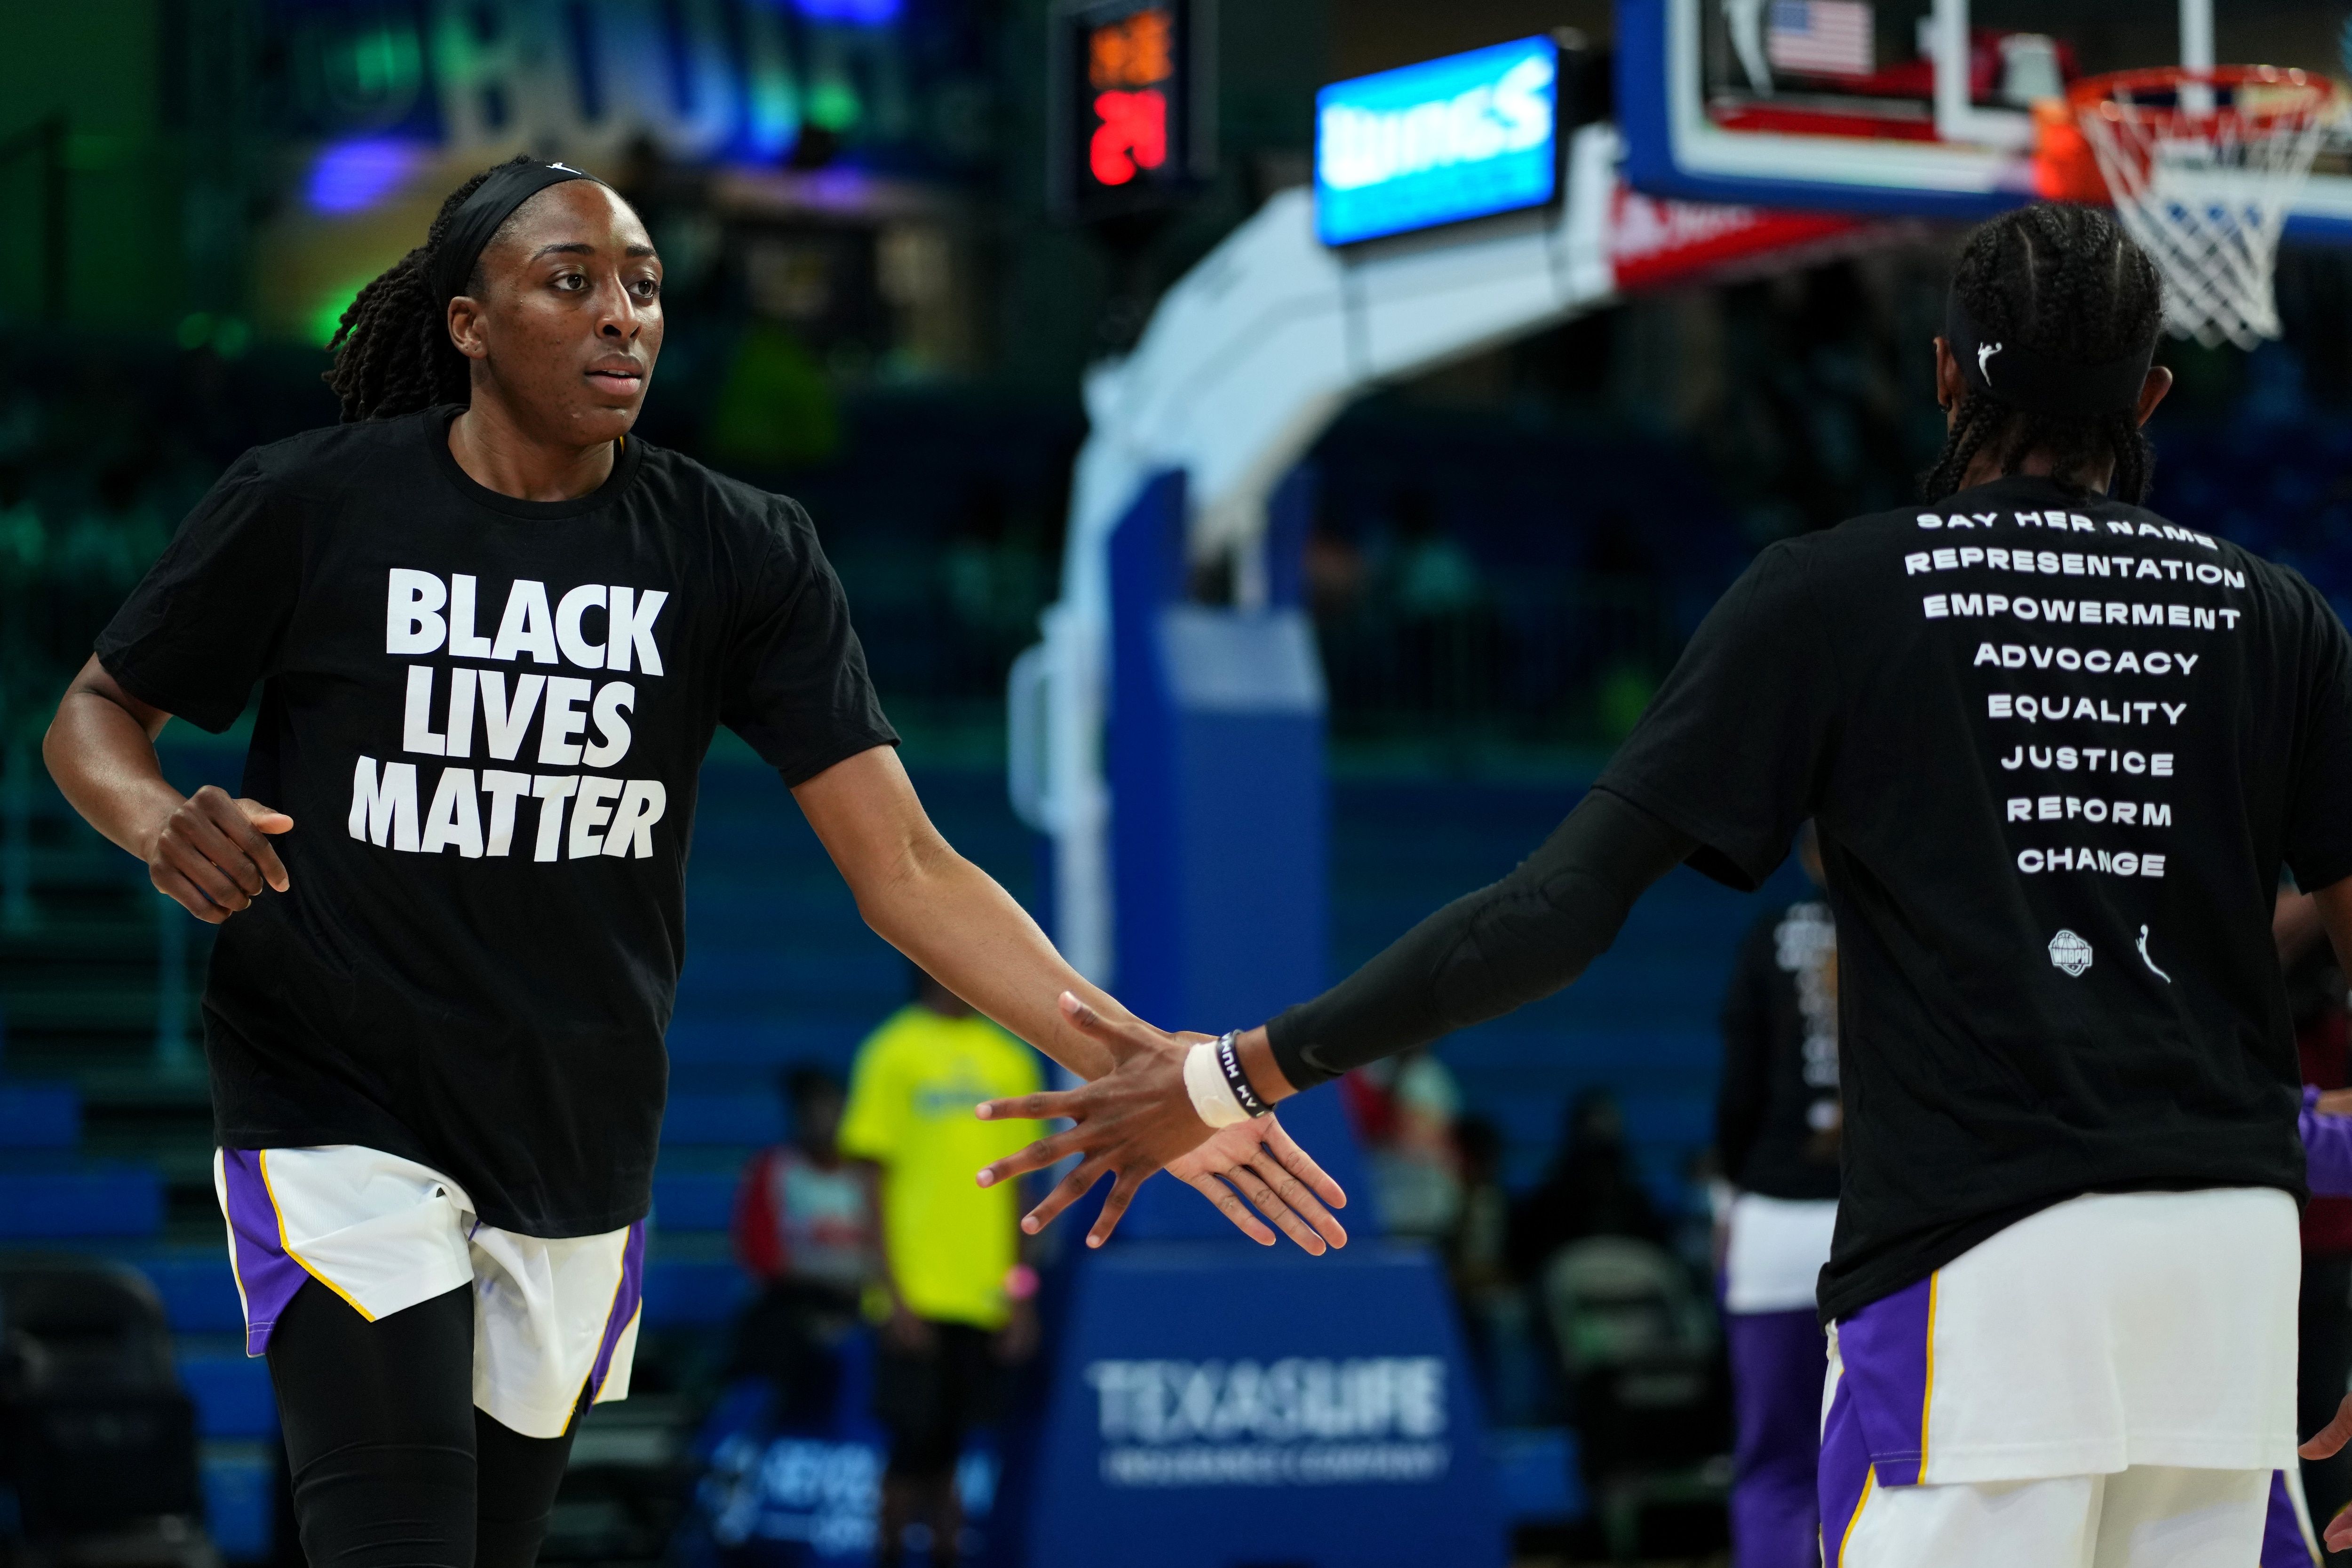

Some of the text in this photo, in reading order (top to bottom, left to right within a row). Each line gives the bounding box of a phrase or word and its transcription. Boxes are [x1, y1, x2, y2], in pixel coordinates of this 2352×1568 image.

[1916, 510, 2218, 551] SAY HER NAME
[1904, 546, 2246, 589] REPRESENTATION
[386, 568, 669, 677] BLACK
[1922, 593, 2241, 630] EMPOWERMENT
[1973, 642, 2199, 675] ADVOCACY
[403, 665, 635, 768] LIVES
[1987, 693, 2187, 725] EQUALITY
[2000, 745, 2174, 777] JUSTICE
[348, 755, 667, 862] MATTER
[2006, 796, 2172, 827] REFORM
[2017, 847, 2166, 877] CHANGE
[1236, 1084, 1257, 1107] AM
